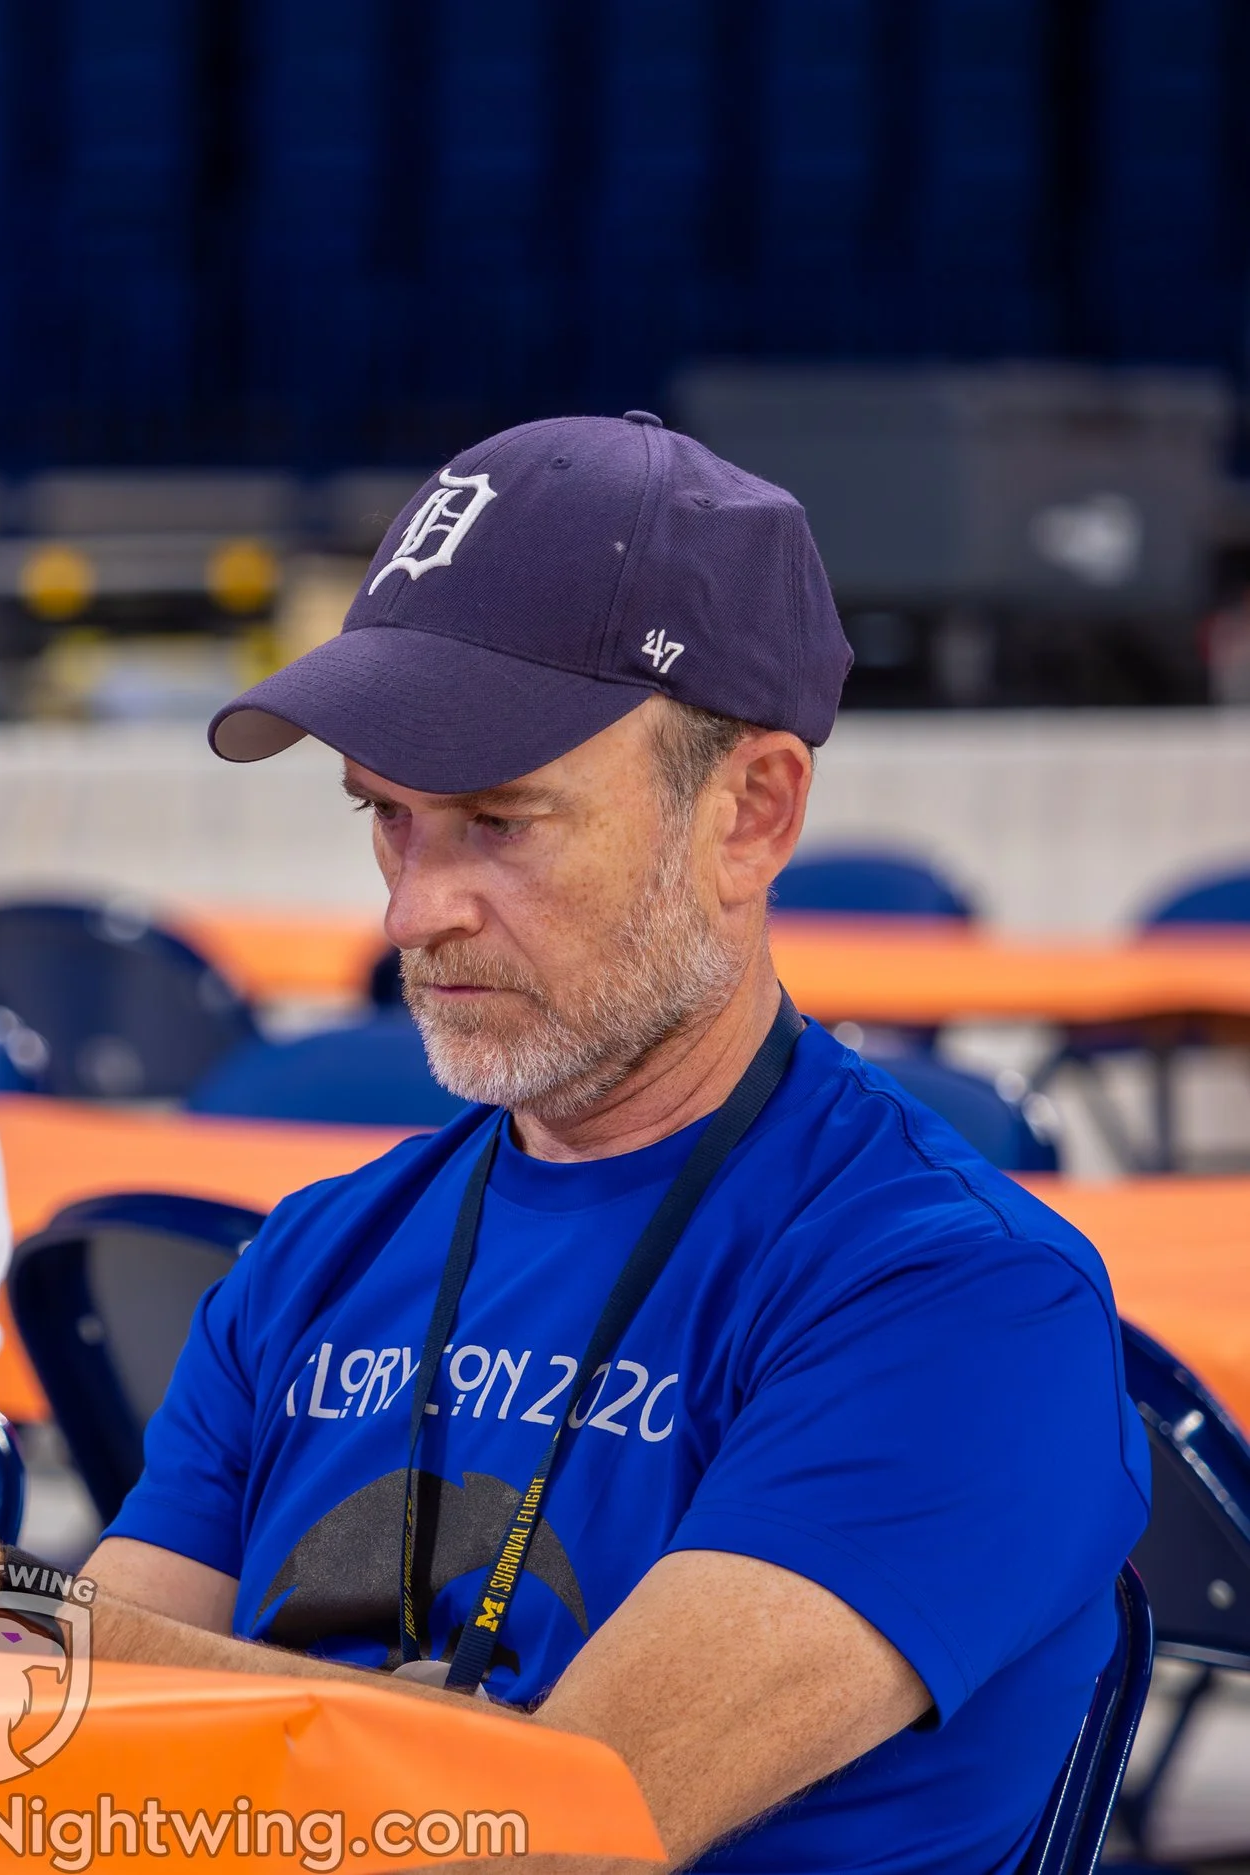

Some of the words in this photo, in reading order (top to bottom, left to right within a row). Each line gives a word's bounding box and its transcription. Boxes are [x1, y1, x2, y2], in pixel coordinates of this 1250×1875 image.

[368, 468, 498, 596] D
[520, 1354, 680, 1443] 2020
[517, 1477, 546, 1523] FLIGHT
[490, 1527, 530, 1592] SURVIVAL
[475, 1596, 506, 1633] M
